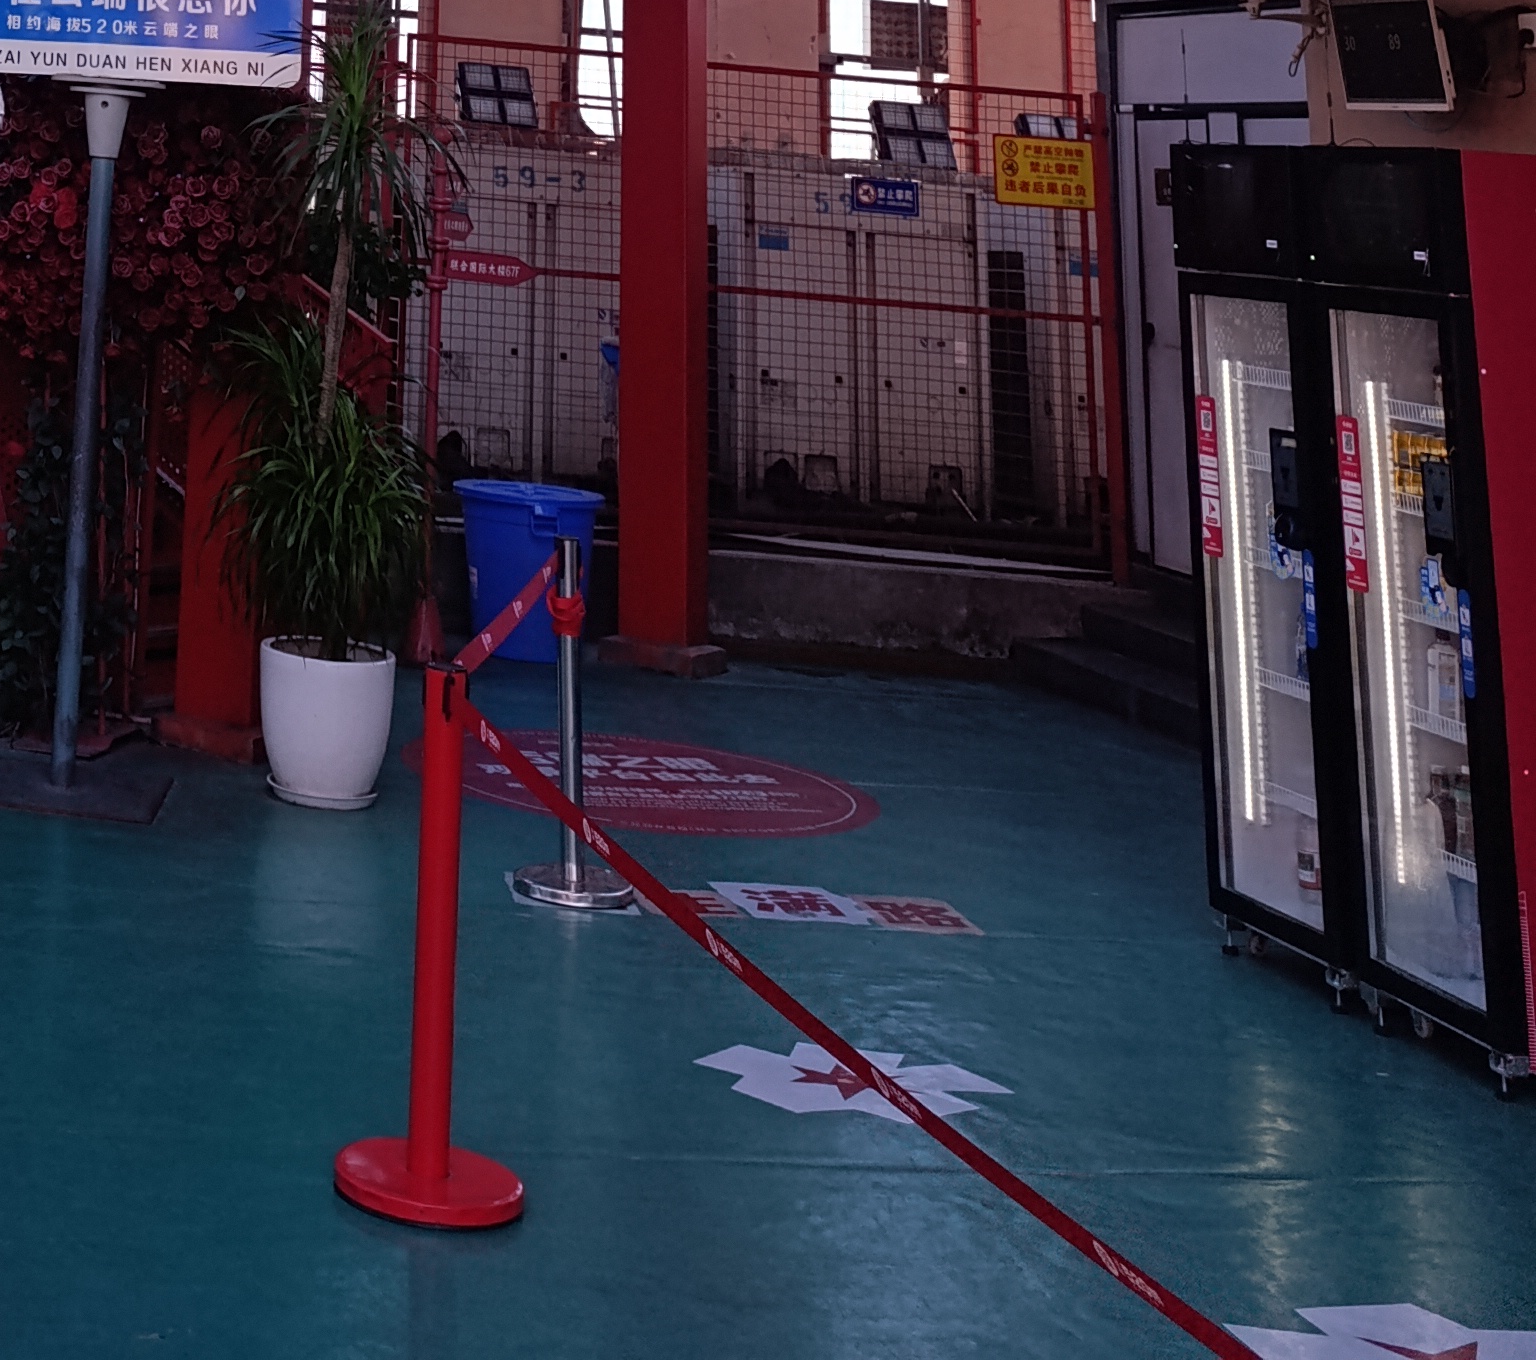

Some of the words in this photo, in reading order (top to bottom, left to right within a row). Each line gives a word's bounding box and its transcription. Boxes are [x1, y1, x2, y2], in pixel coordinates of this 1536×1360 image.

[6, 14, 220, 40] 相约海拔520米云端之眼
[30, 50, 67, 67] YUN
[76, 53, 126, 70] DUAN
[136, 56, 172, 73] HEN
[181, 58, 238, 76] XIANG
[247, 61, 265, 77] NI
[1005, 179, 1087, 198] 违者后果自负
